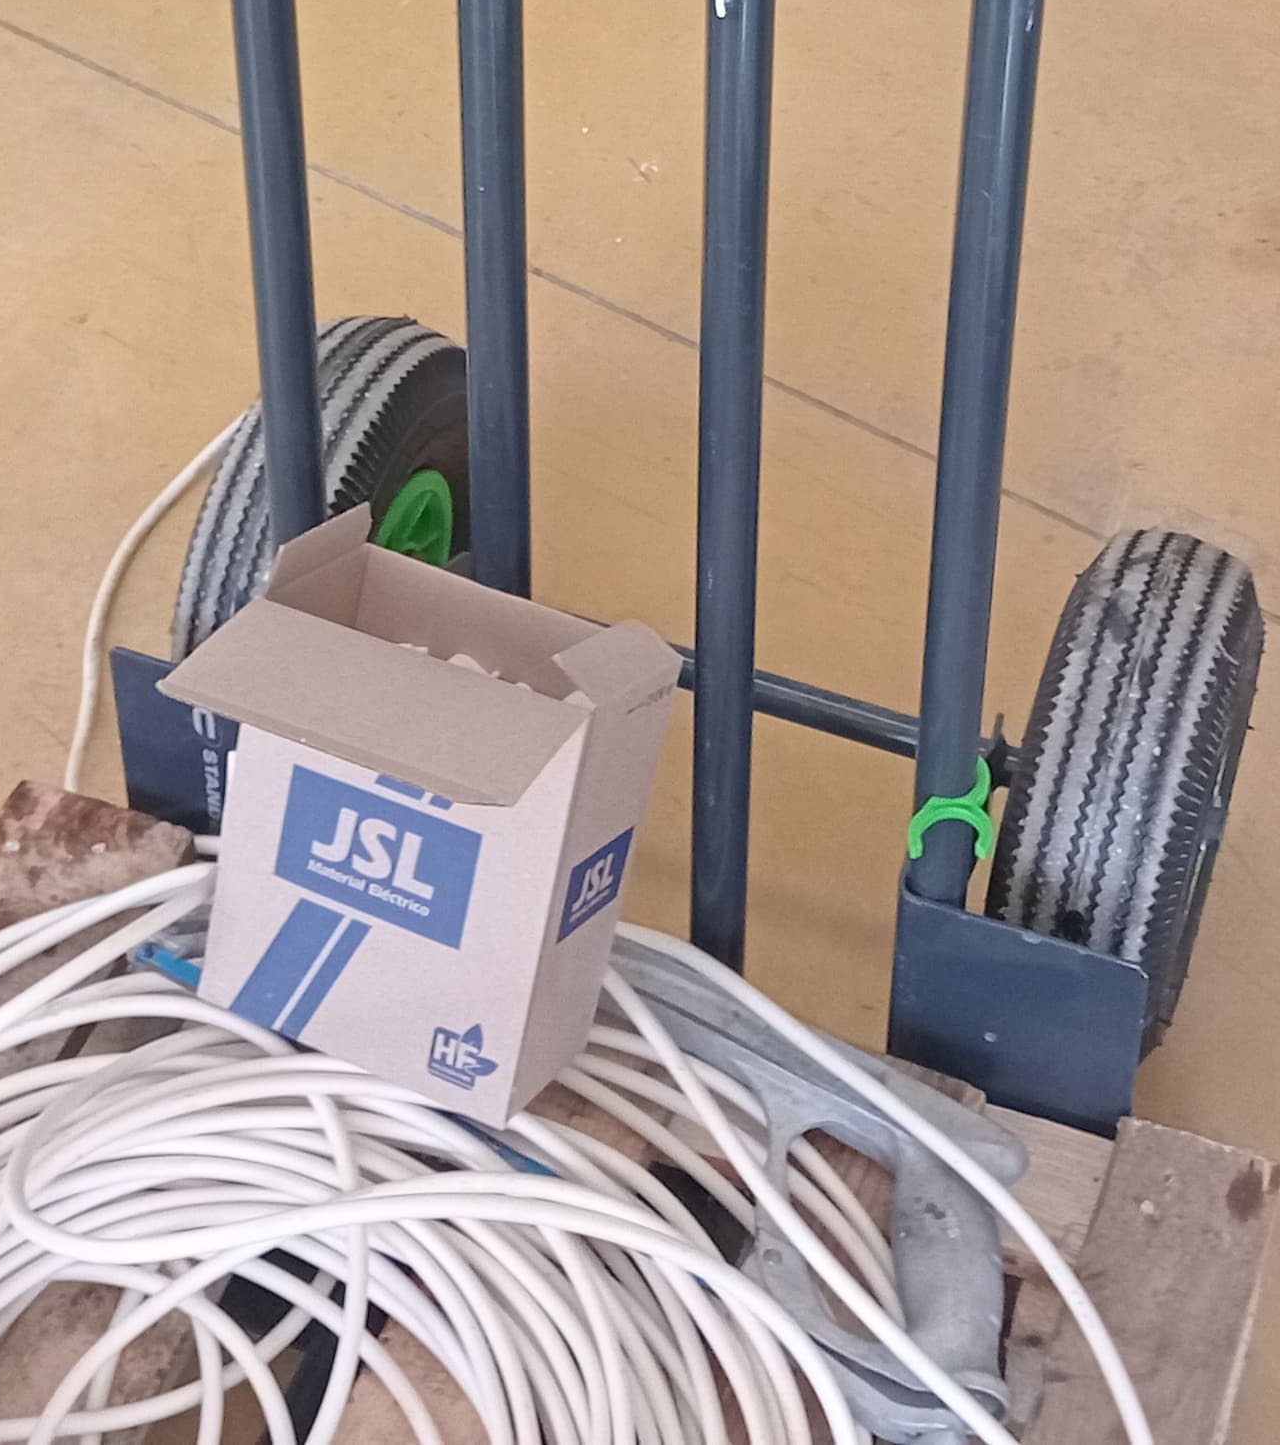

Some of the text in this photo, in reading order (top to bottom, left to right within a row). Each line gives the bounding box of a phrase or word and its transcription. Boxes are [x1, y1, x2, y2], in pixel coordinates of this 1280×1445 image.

[306, 858, 367, 891] Material
[310, 807, 435, 901] JSL
[571, 852, 614, 913] JSL
